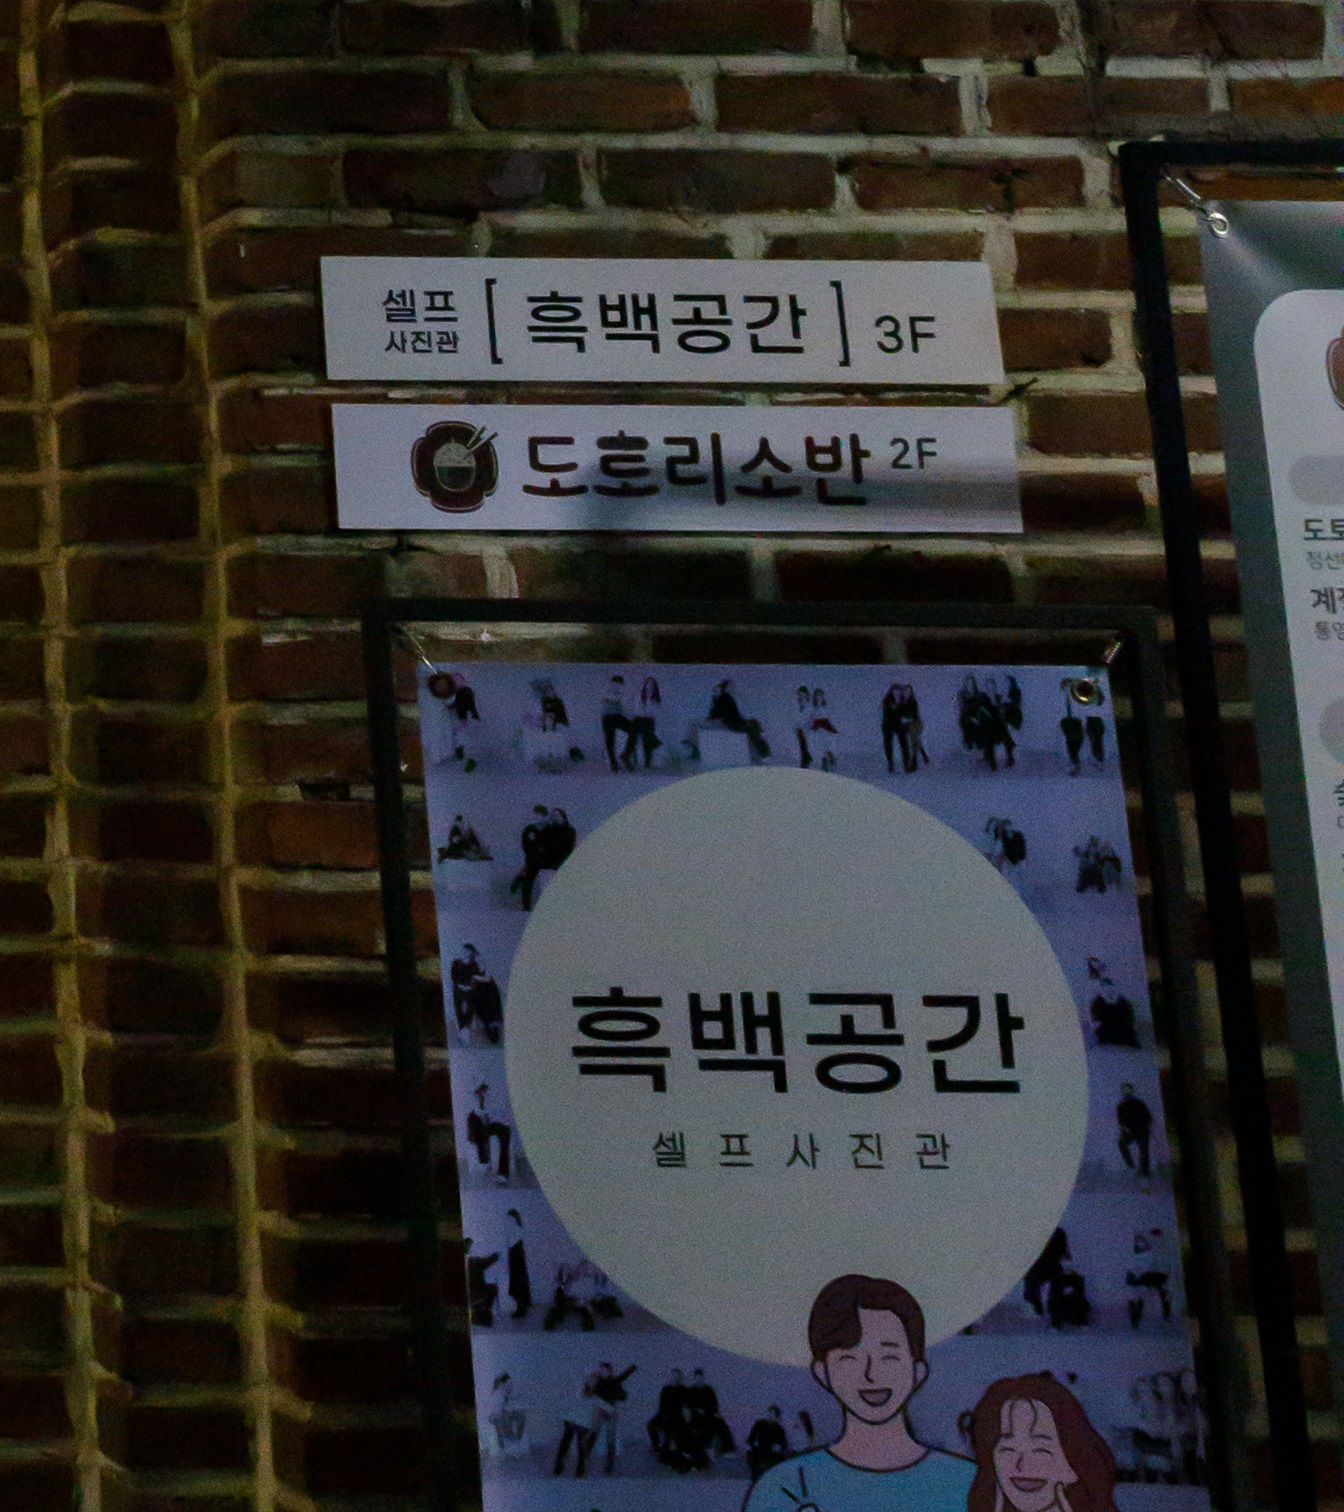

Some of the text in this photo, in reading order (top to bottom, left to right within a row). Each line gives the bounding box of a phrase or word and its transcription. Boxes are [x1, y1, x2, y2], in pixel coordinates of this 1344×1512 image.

[381, 287, 459, 325] 셀프
[526, 289, 937, 355] 흑백공간 3F
[383, 329, 460, 355] 사진관
[522, 430, 938, 506] 도토리소반 2F
[572, 986, 1025, 1094] 흑백공간
